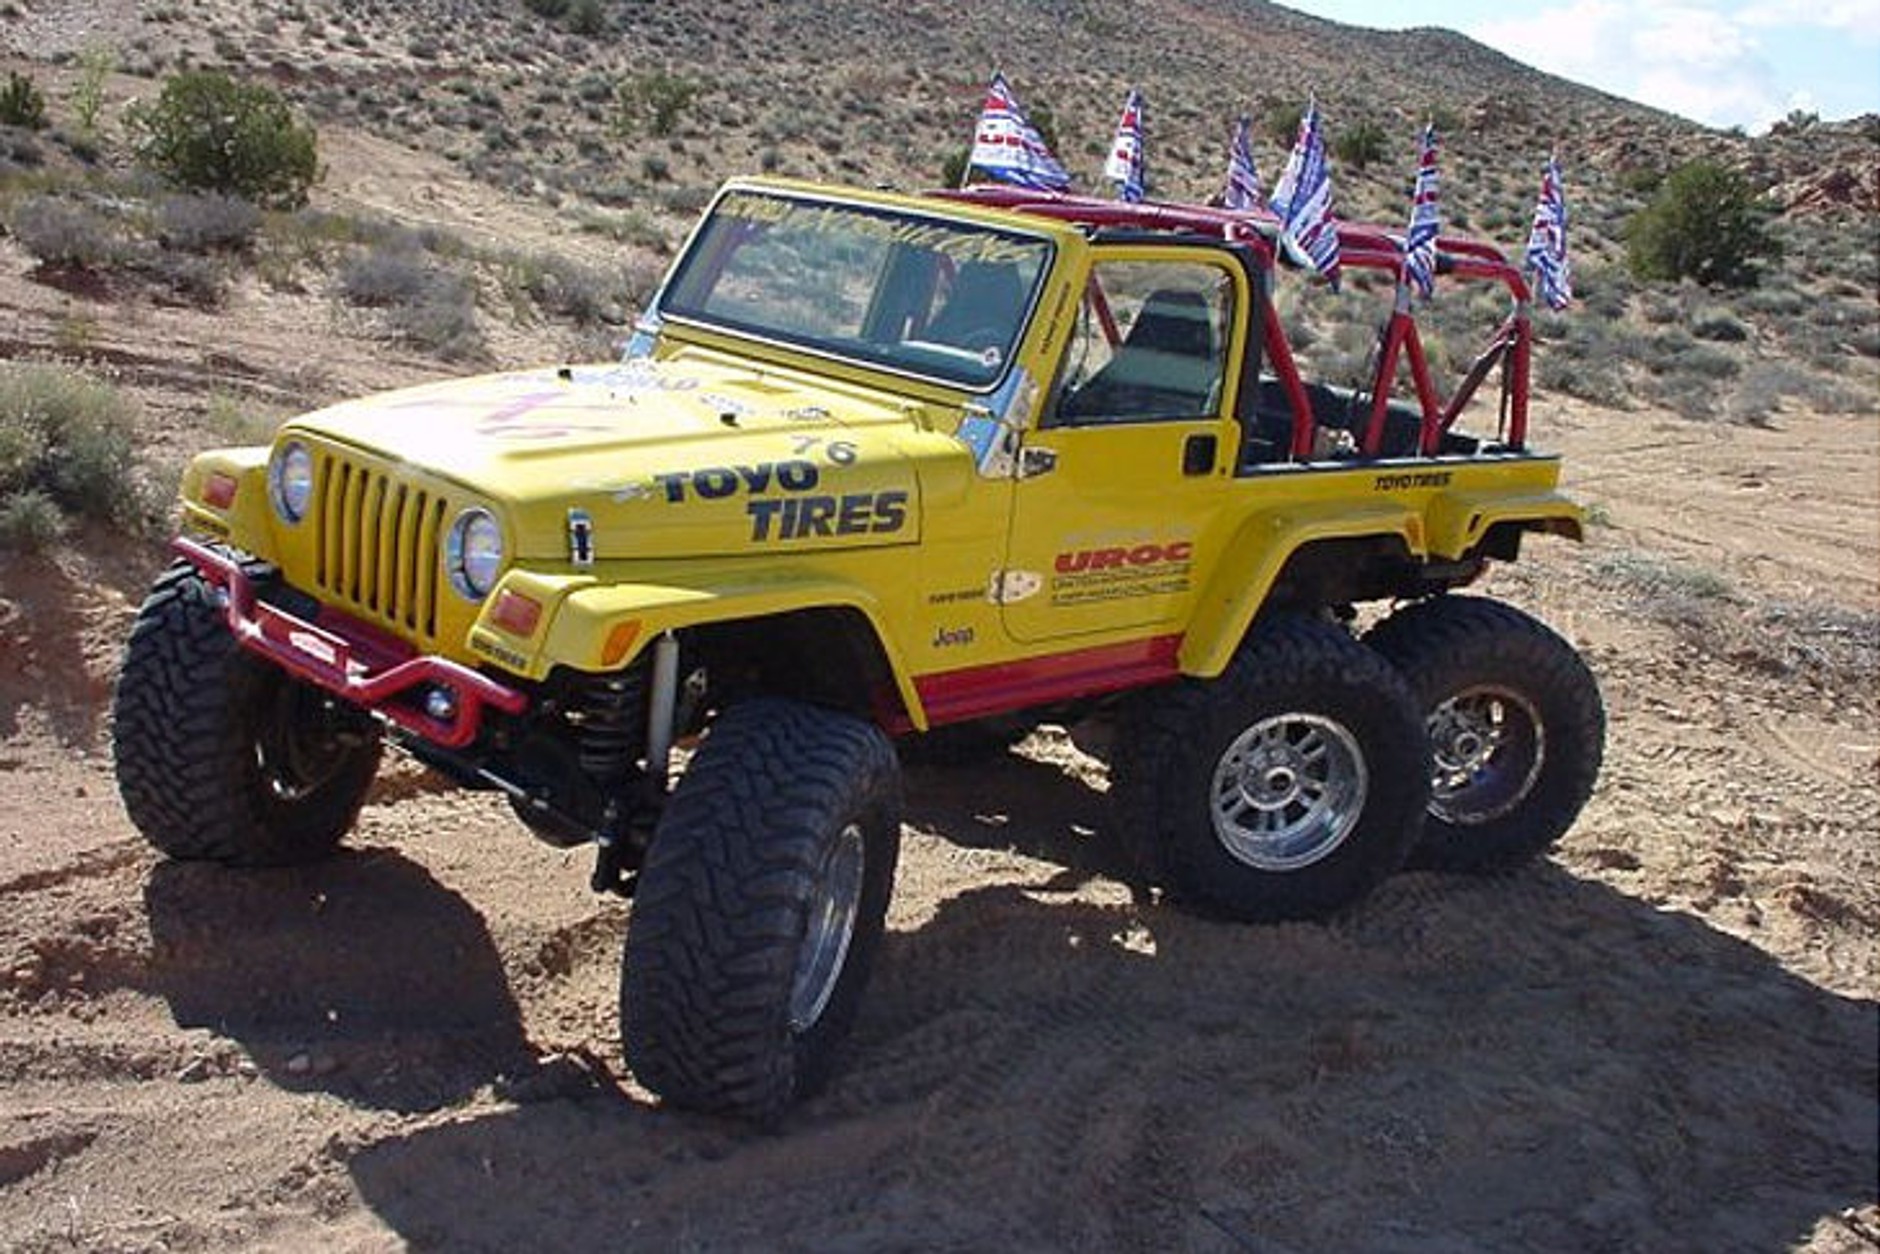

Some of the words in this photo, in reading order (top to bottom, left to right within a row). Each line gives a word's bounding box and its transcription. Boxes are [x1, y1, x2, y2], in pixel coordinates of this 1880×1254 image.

[655, 460, 819, 503] TOYO
[747, 491, 908, 542] TIRES
[1054, 542, 1193, 573] UROC
[932, 624, 975, 648] Jeep
